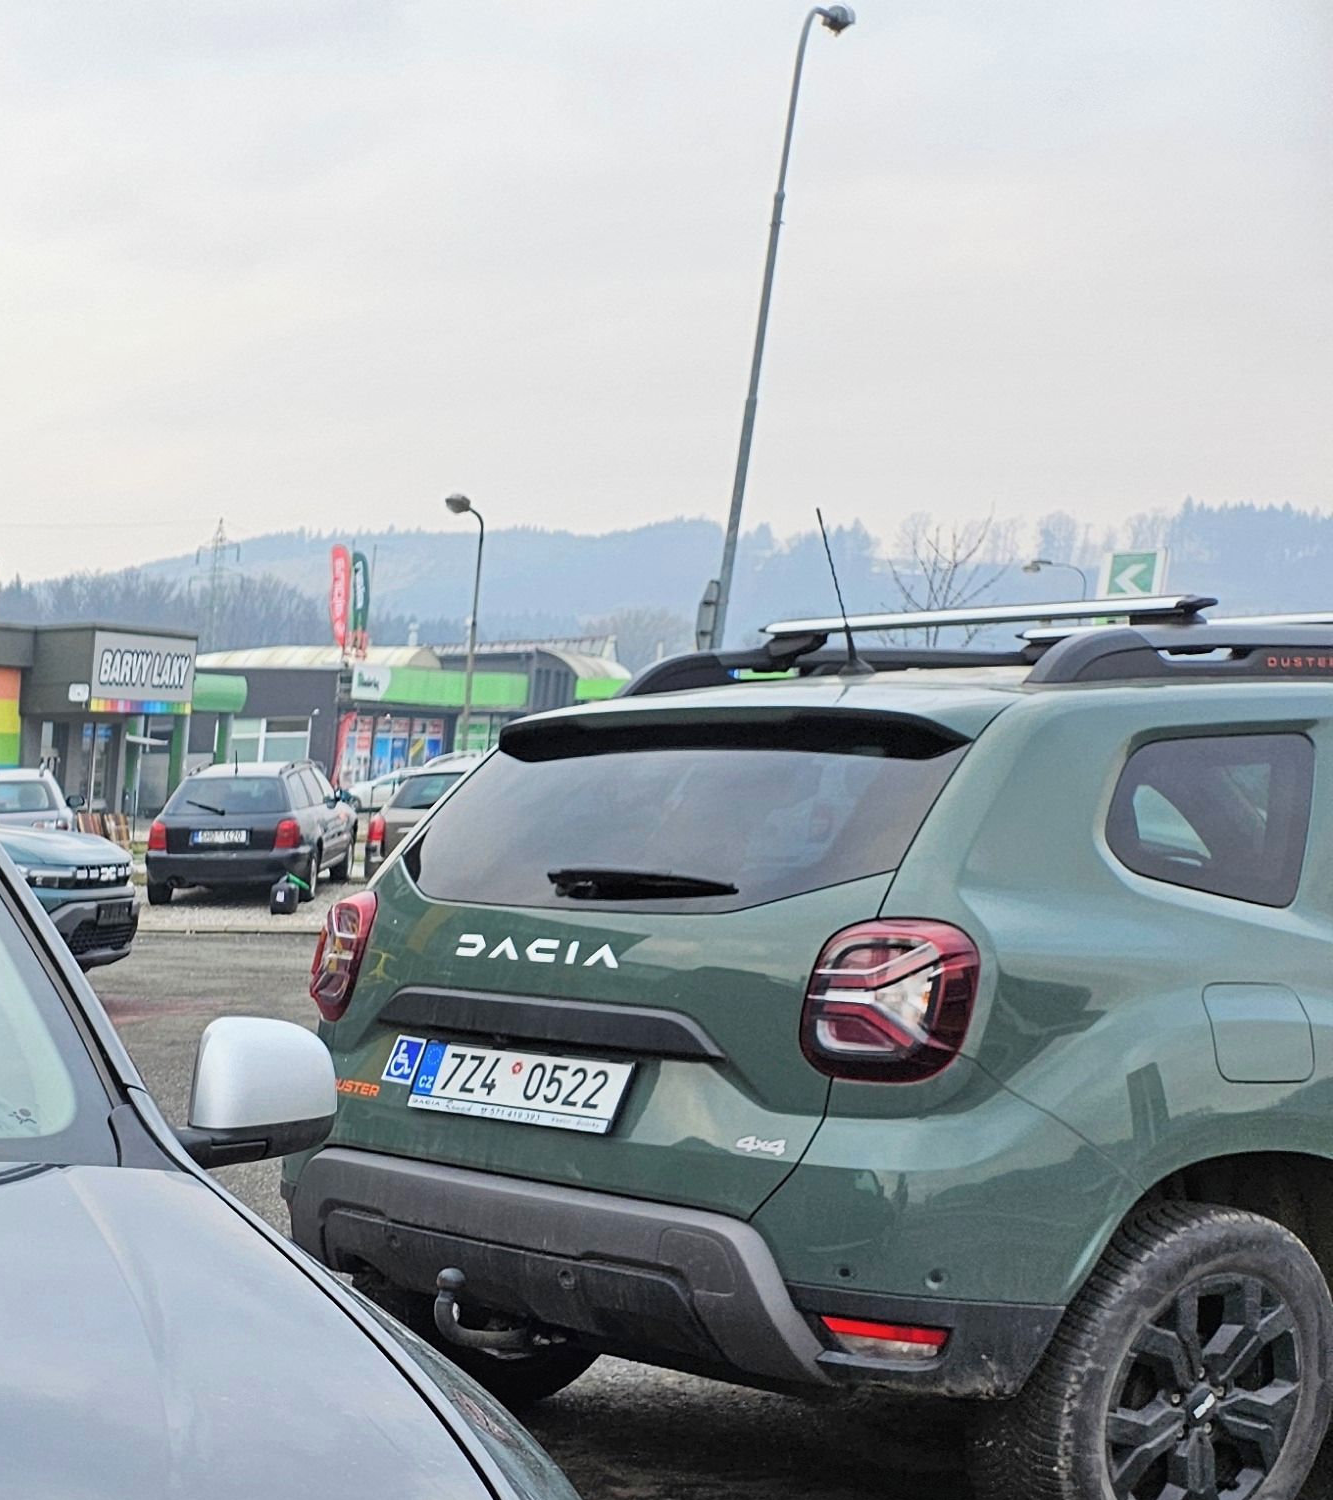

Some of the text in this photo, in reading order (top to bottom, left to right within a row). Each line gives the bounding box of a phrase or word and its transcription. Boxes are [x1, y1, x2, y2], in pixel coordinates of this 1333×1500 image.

[99, 648, 191, 689] BARVY LAKY
[455, 933, 619, 969] DACIA
[335, 1079, 380, 1097] USTER
[418, 1074, 435, 1089] CZ
[440, 1052, 609, 1110] 7Z4 0522
[736, 1135, 787, 1157] 4x4
